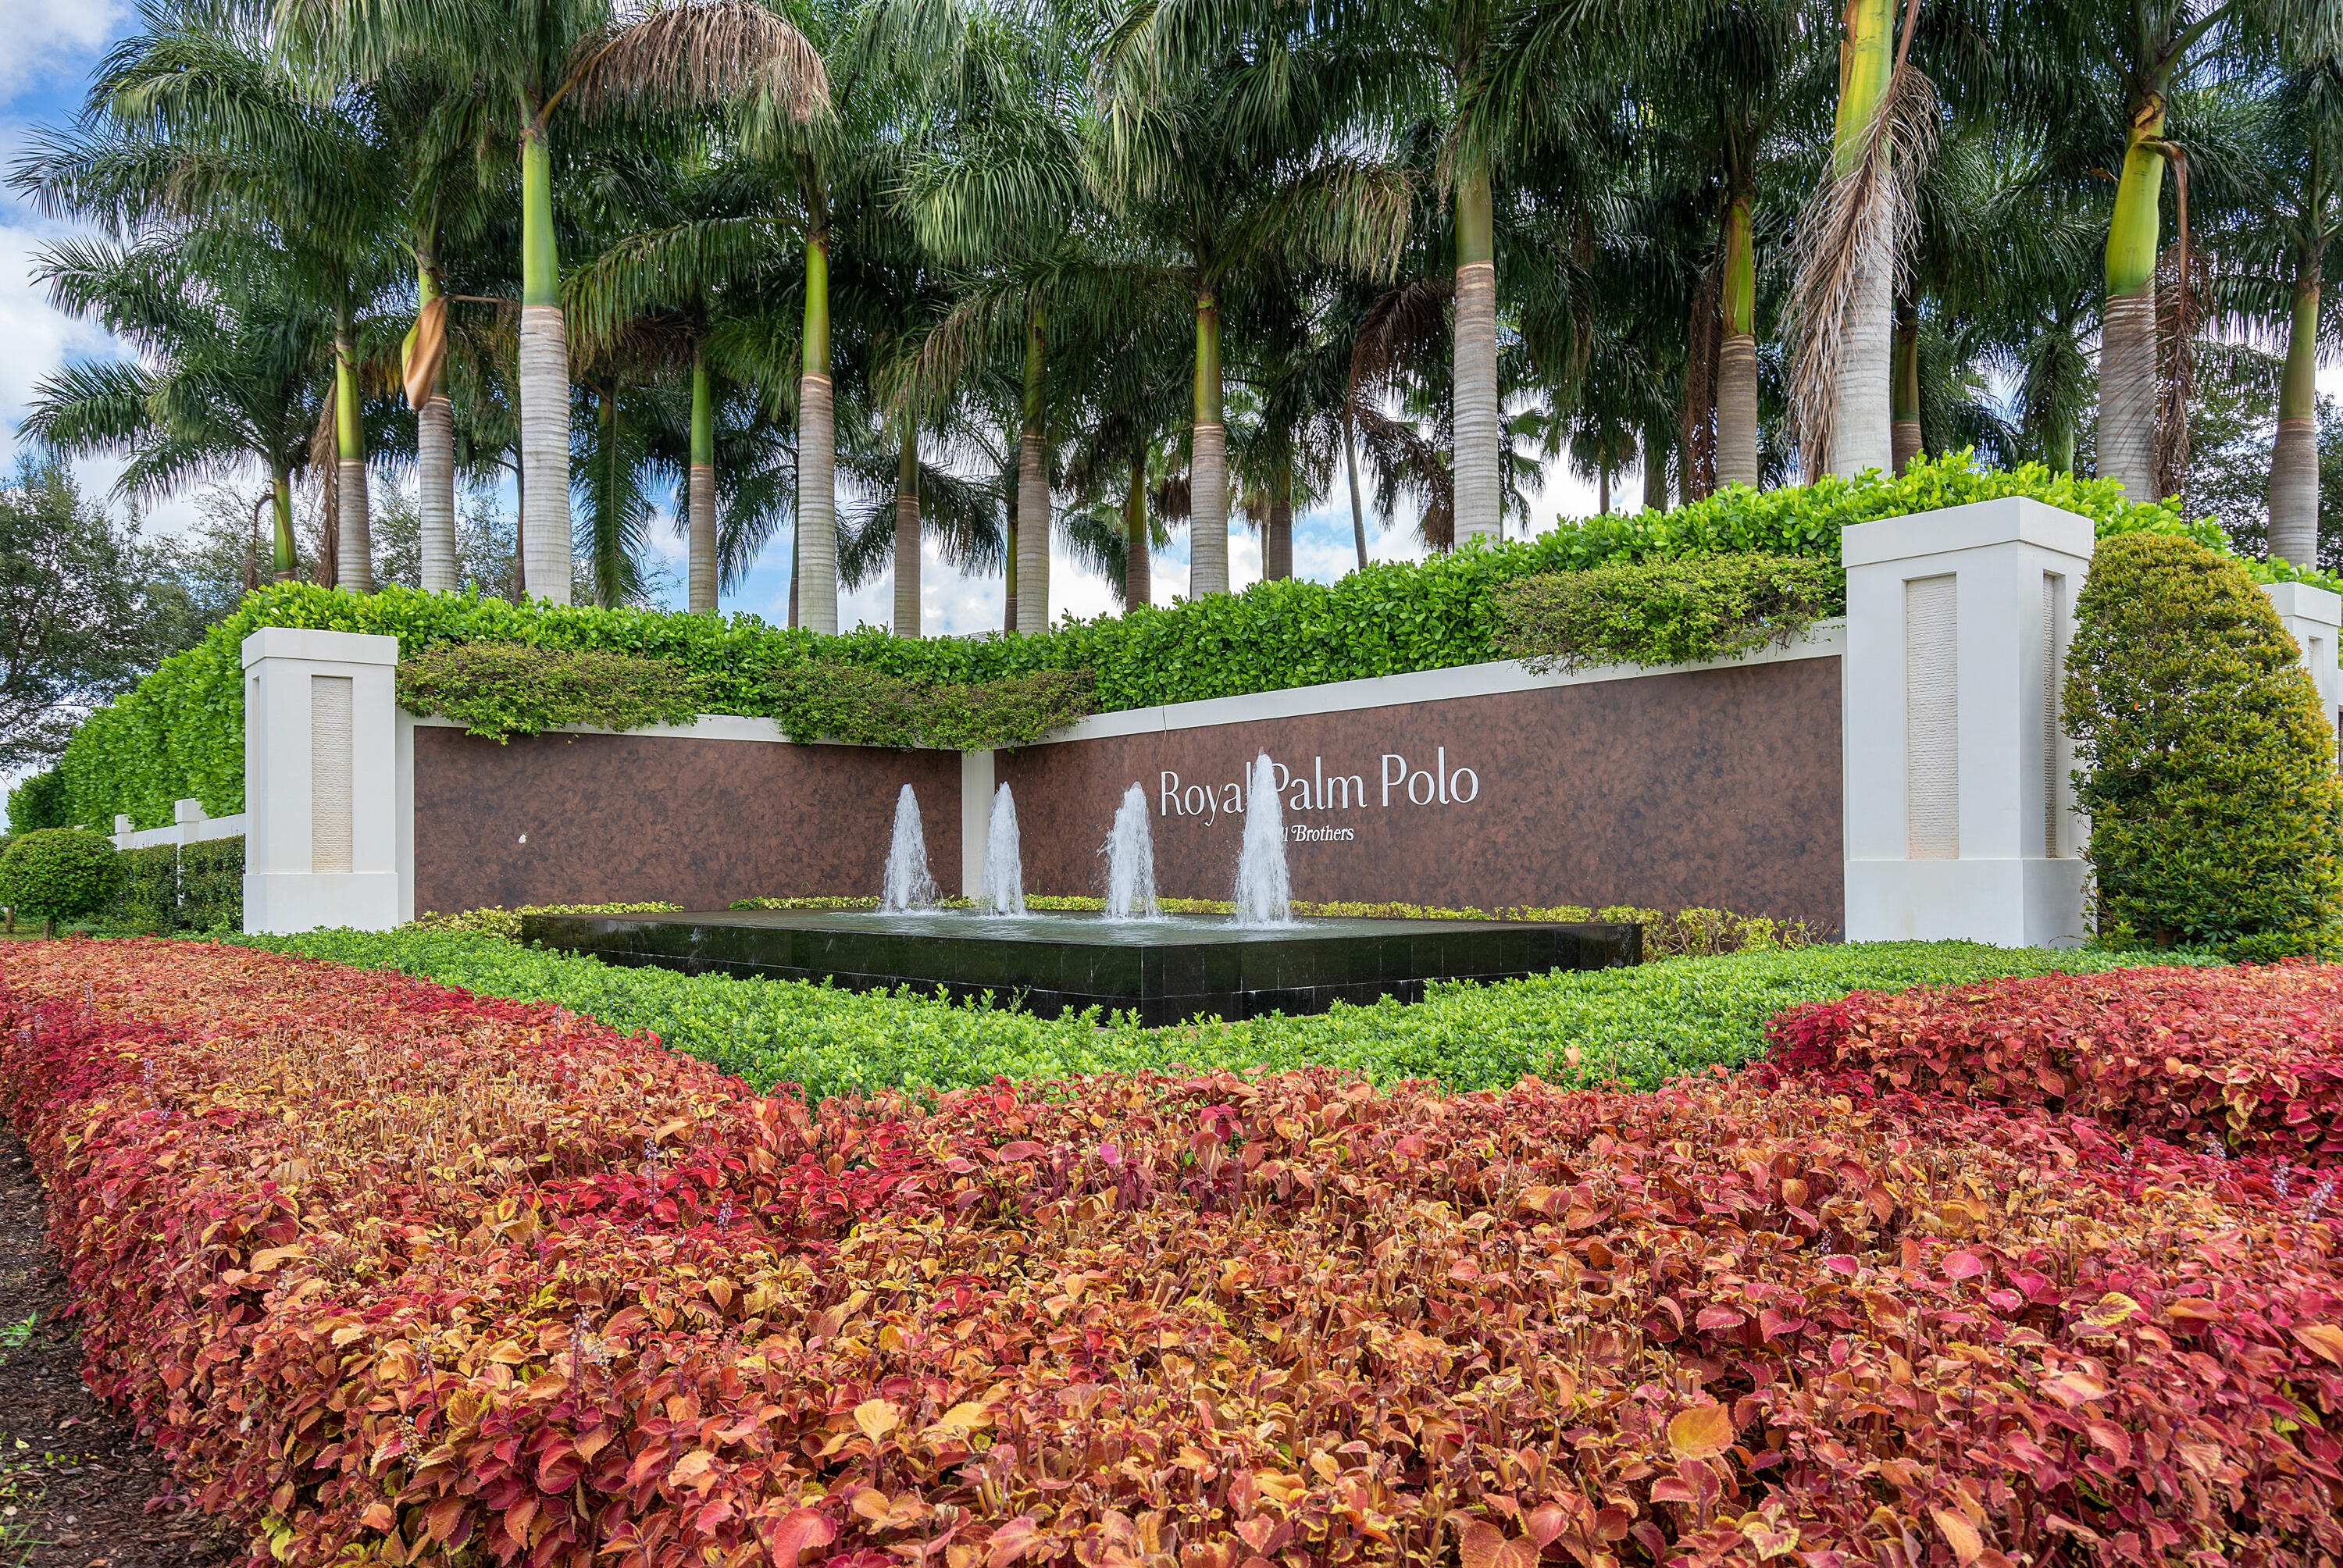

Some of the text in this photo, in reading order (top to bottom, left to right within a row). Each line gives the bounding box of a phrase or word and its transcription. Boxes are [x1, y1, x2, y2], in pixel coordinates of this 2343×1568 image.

[1161, 761, 1251, 827] Royal
[1382, 747, 1478, 807] Polo
[1291, 825, 1354, 842] Brothers
